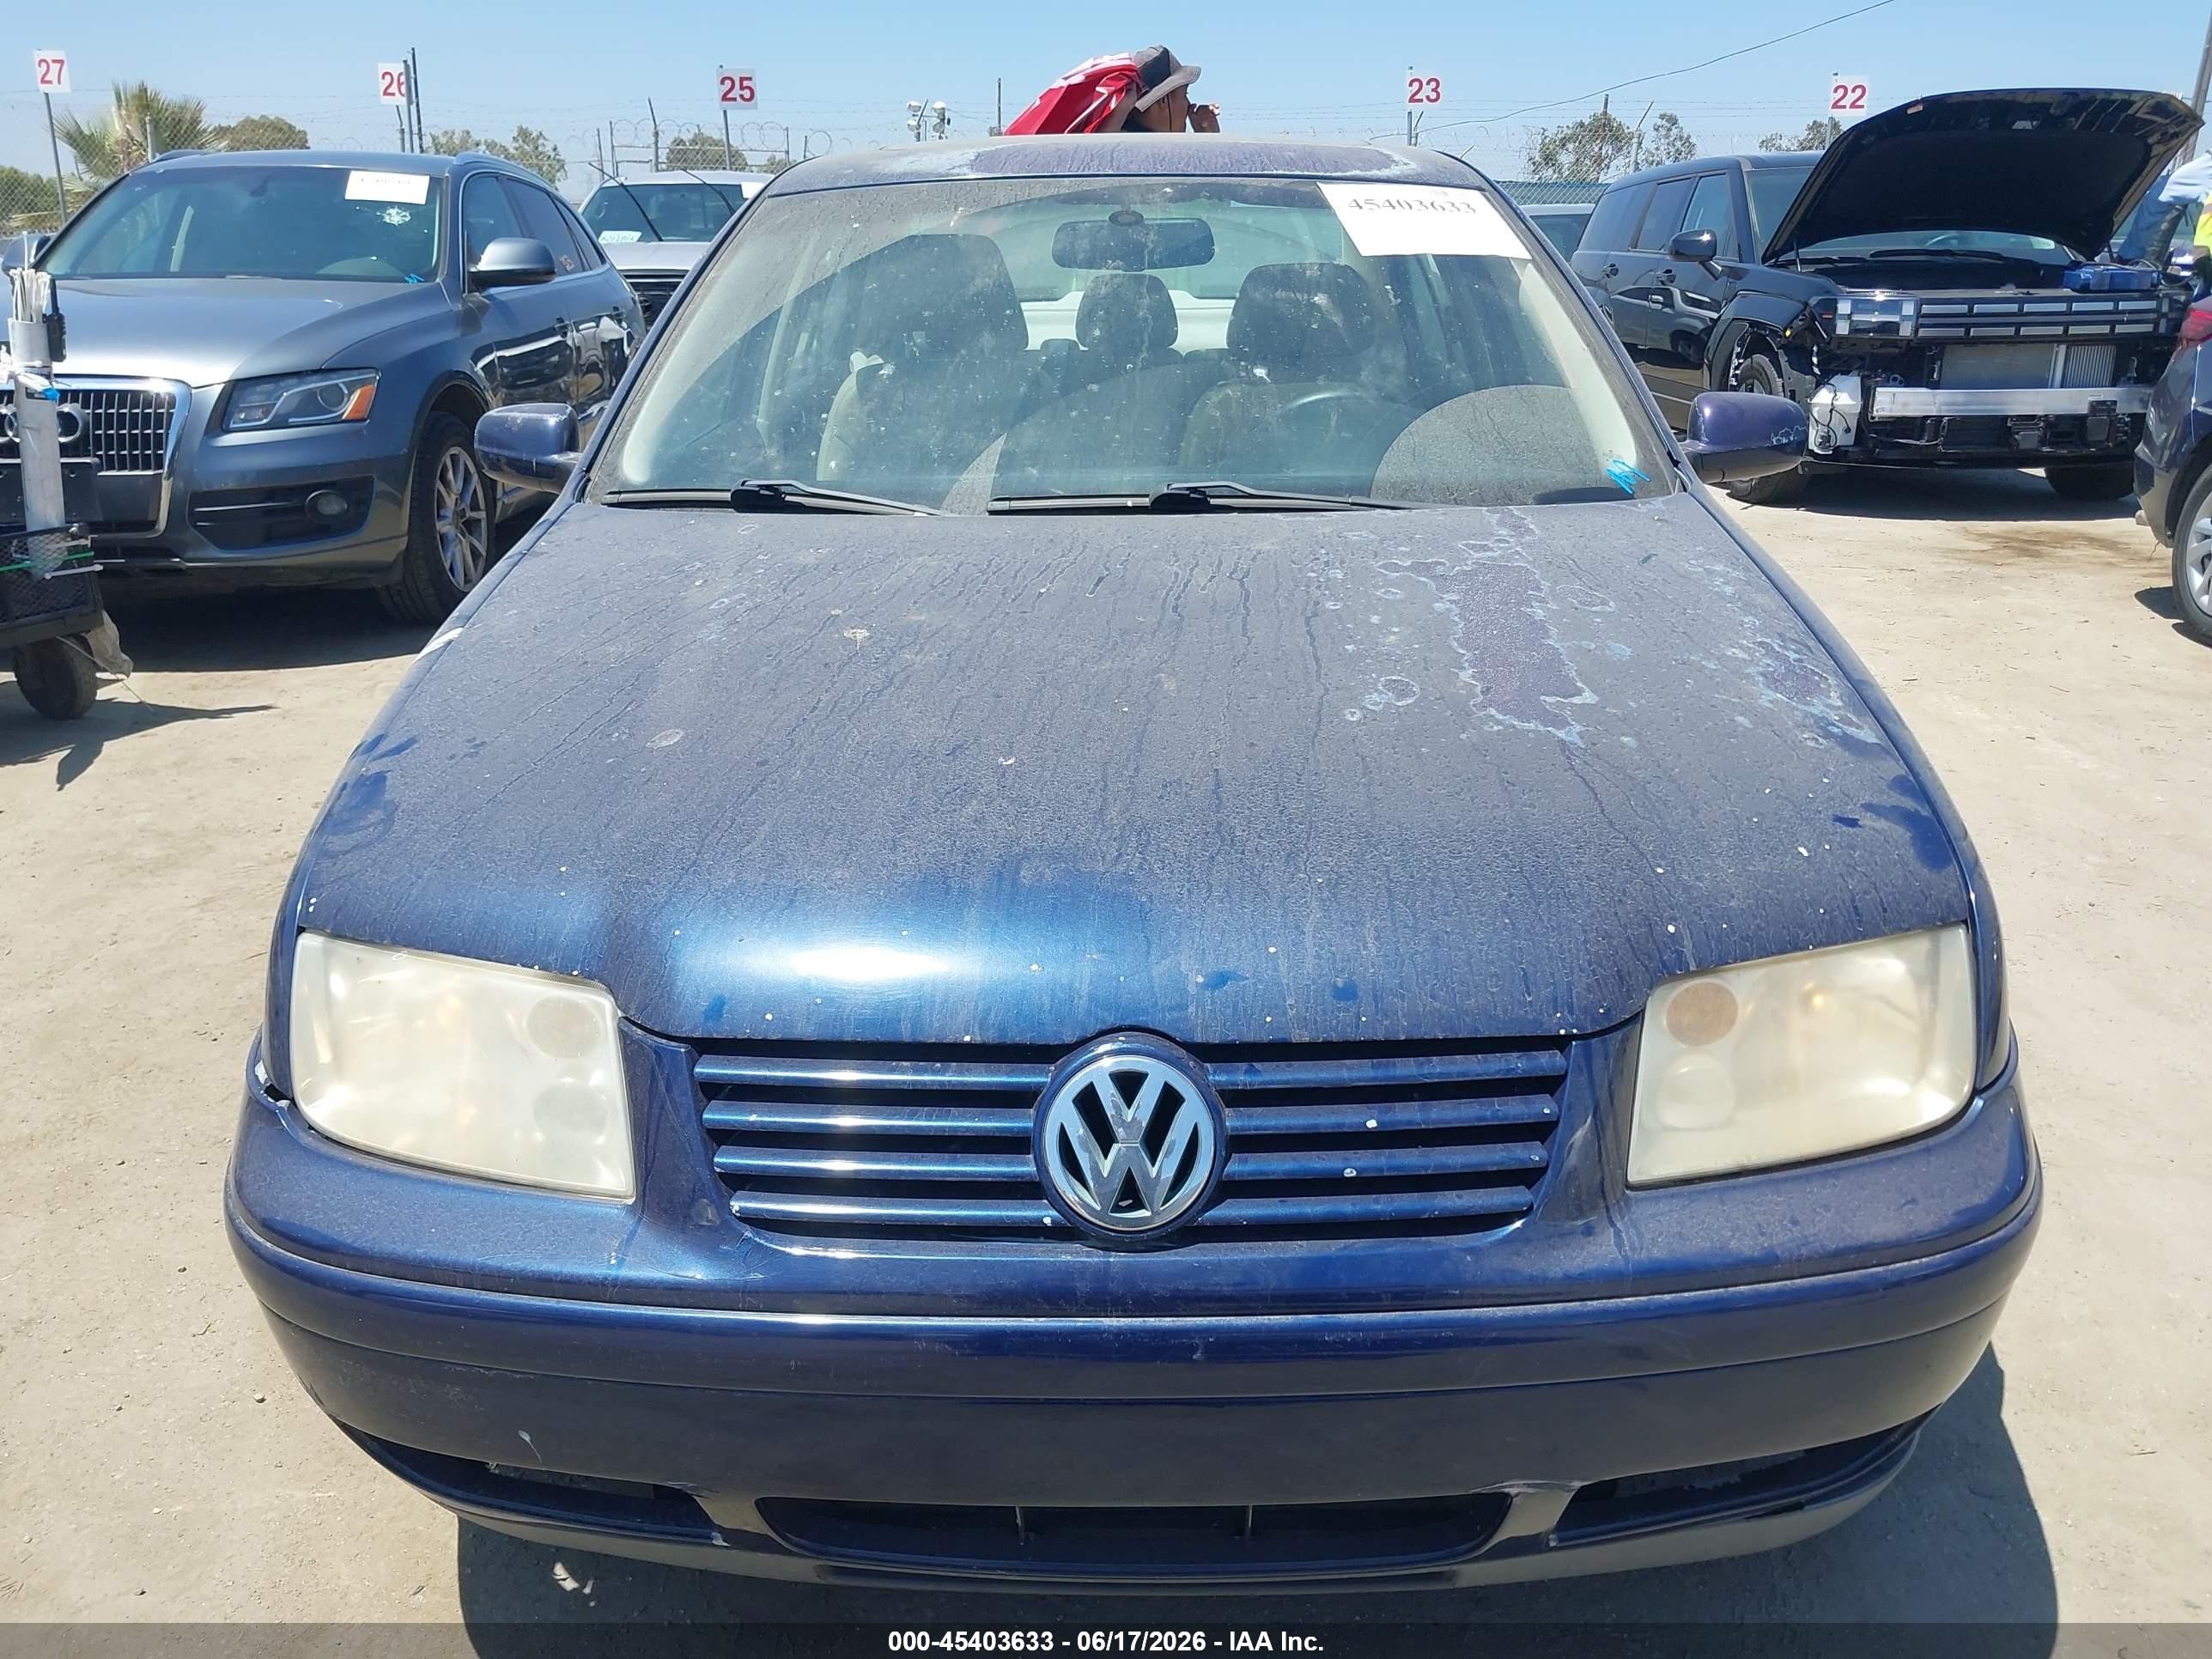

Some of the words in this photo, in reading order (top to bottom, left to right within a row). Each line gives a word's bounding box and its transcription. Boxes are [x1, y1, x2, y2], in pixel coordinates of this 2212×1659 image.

[38, 58, 64, 85] 27
[720, 76, 755, 102] 25
[1408, 77, 1441, 103] 23
[1831, 84, 1867, 109] 22
[1347, 198, 1476, 214] 45403633
[1044, 1054, 1215, 1231] VW
